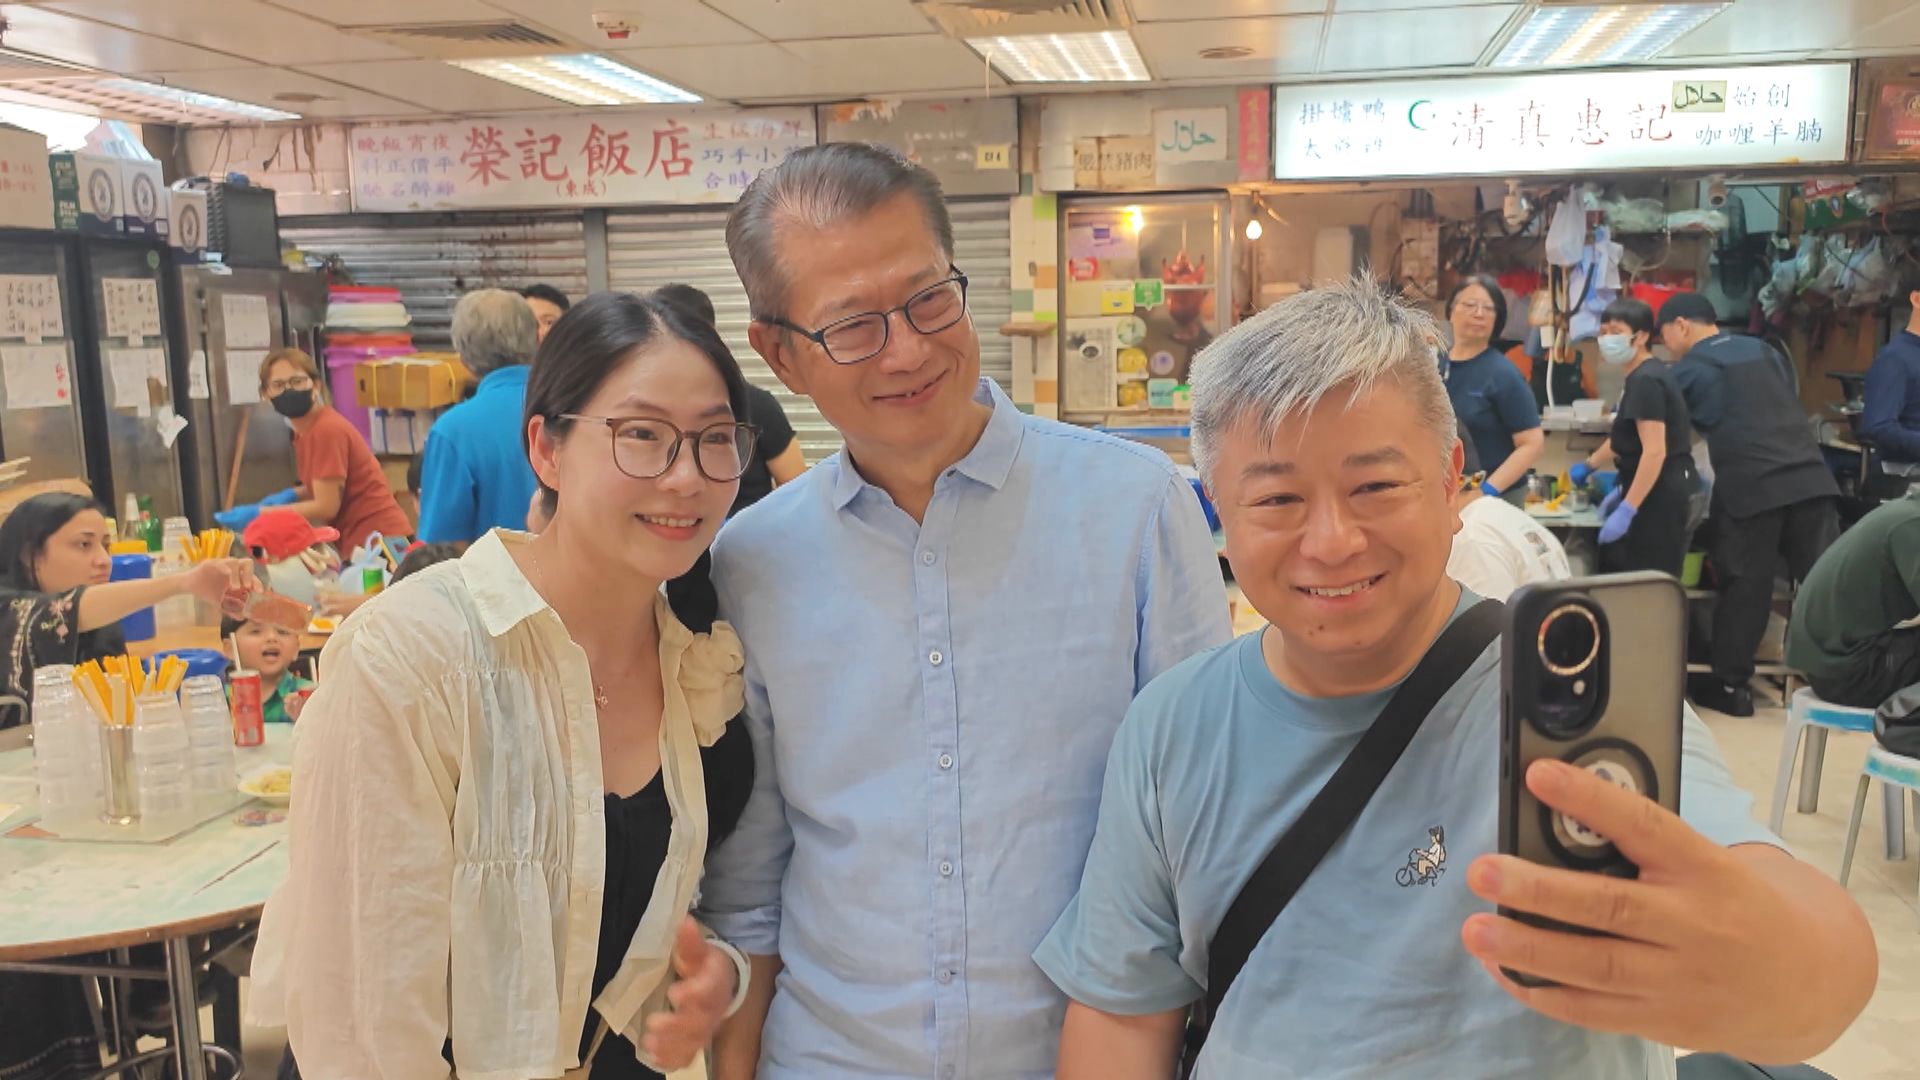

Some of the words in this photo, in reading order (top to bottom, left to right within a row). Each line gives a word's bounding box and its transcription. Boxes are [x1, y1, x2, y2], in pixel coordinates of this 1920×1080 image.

[1674, 84, 1723, 109] حلال
[1161, 120, 1216, 151] حلال
[1451, 98, 1673, 150] 清真惠記
[460, 119, 696, 186] 榮記飯店
